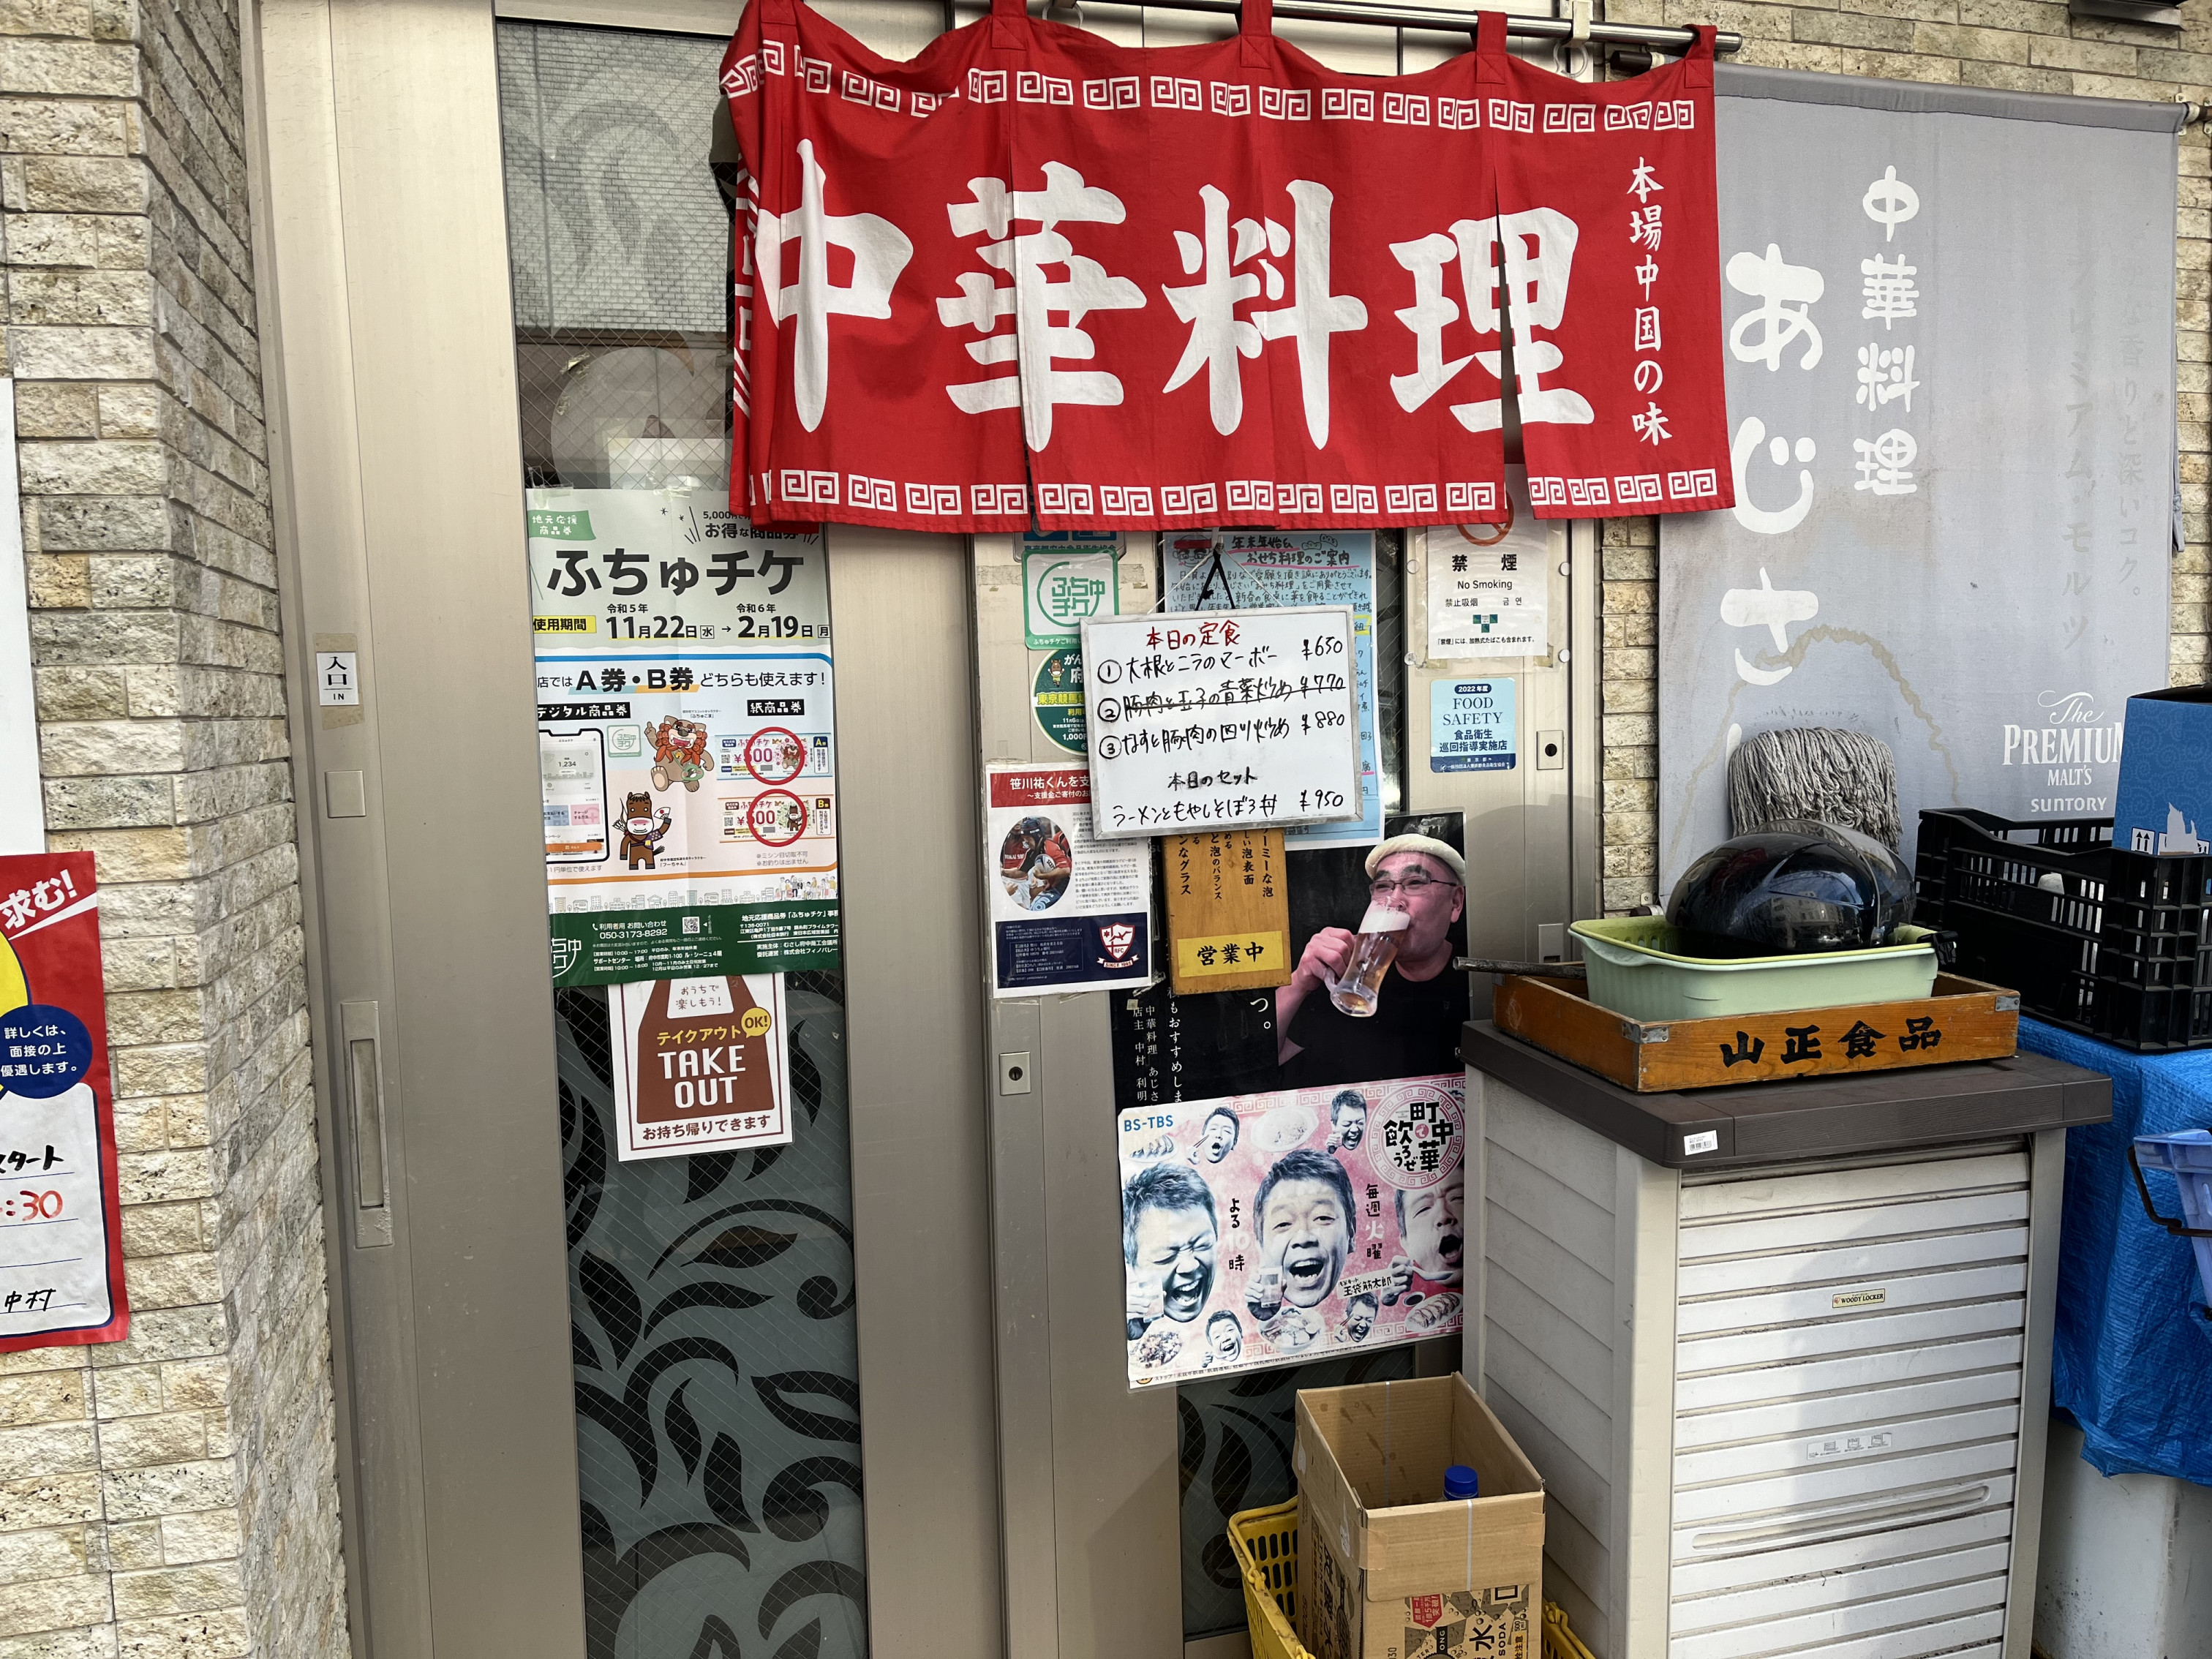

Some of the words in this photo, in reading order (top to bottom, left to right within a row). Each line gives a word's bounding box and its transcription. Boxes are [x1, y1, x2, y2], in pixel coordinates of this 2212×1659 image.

[755, 138, 1595, 452] 中華料理
[1626, 156, 1673, 446] 本場中国の味
[1853, 165, 1921, 495] 中華料理
[532, 514, 578, 526] 地元応援
[1719, 242, 1826, 783] あじさ
[539, 525, 573, 536] 商品券
[1246, 549, 1350, 567] おせち料理のご案内
[1451, 554, 1518, 572] 禁煙
[546, 548, 805, 597] ふちゅチケ
[1457, 580, 1470, 590] No
[1472, 579, 1513, 590] Smoking
[606, 603, 649, 614] 令和5年
[736, 602, 776, 614] 令和6年
[1445, 598, 1478, 608] 禁止吸烟
[533, 617, 587, 632] 使用期間
[1146, 619, 1241, 651] 本日の定食
[325, 655, 348, 686] 入口
[538, 704, 628, 718] デジタル商品券
[750, 701, 802, 714] 紙商品券
[1453, 696, 1494, 710] FOOD
[2037, 690, 2104, 725] The
[1442, 712, 1504, 726] SAFETY
[1453, 729, 1494, 741] 食品衛生
[1439, 740, 1508, 753] 巡回指導実施店
[1167, 767, 1258, 791] 本日のセット
[2047, 765, 2093, 786] MALT'S
[2031, 797, 2107, 813] SUNTORY
[600, 928, 668, 939] 050-3173-8292
[1197, 941, 1265, 966] 営業中
[680, 984, 720, 996] おうちで
[1133, 1006, 1144, 1031] 店主
[4, 1024, 67, 1040] 詳しくは、
[656, 1025, 742, 1046] テイクアウト
[744, 1015, 768, 1028] OK!
[1146, 1005, 1158, 1055] 中華料理
[9, 1042, 67, 1058] 面接の上
[1719, 1015, 1943, 1068] 山正食品
[657, 1044, 747, 1080] TAKE
[1135, 1042, 1146, 1066] 中村
[0, 1060, 78, 1078] 優遇します。
[674, 1076, 738, 1109] OUT
[1136, 1077, 1147, 1102] 利明
[642, 1114, 771, 1140] お持ち帰りできます
[1123, 1113, 1174, 1132] BS-TBS
[1365, 1183, 1385, 1260] 毎週火曜
[1343, 1276, 1392, 1297] 玉袋筋太郎
[1862, 1293, 1884, 1301] LOCKER
[4, 1287, 56, 1312] 中村
[1469, 1624, 1496, 1659] 水
[1499, 1622, 1507, 1657] SODA
